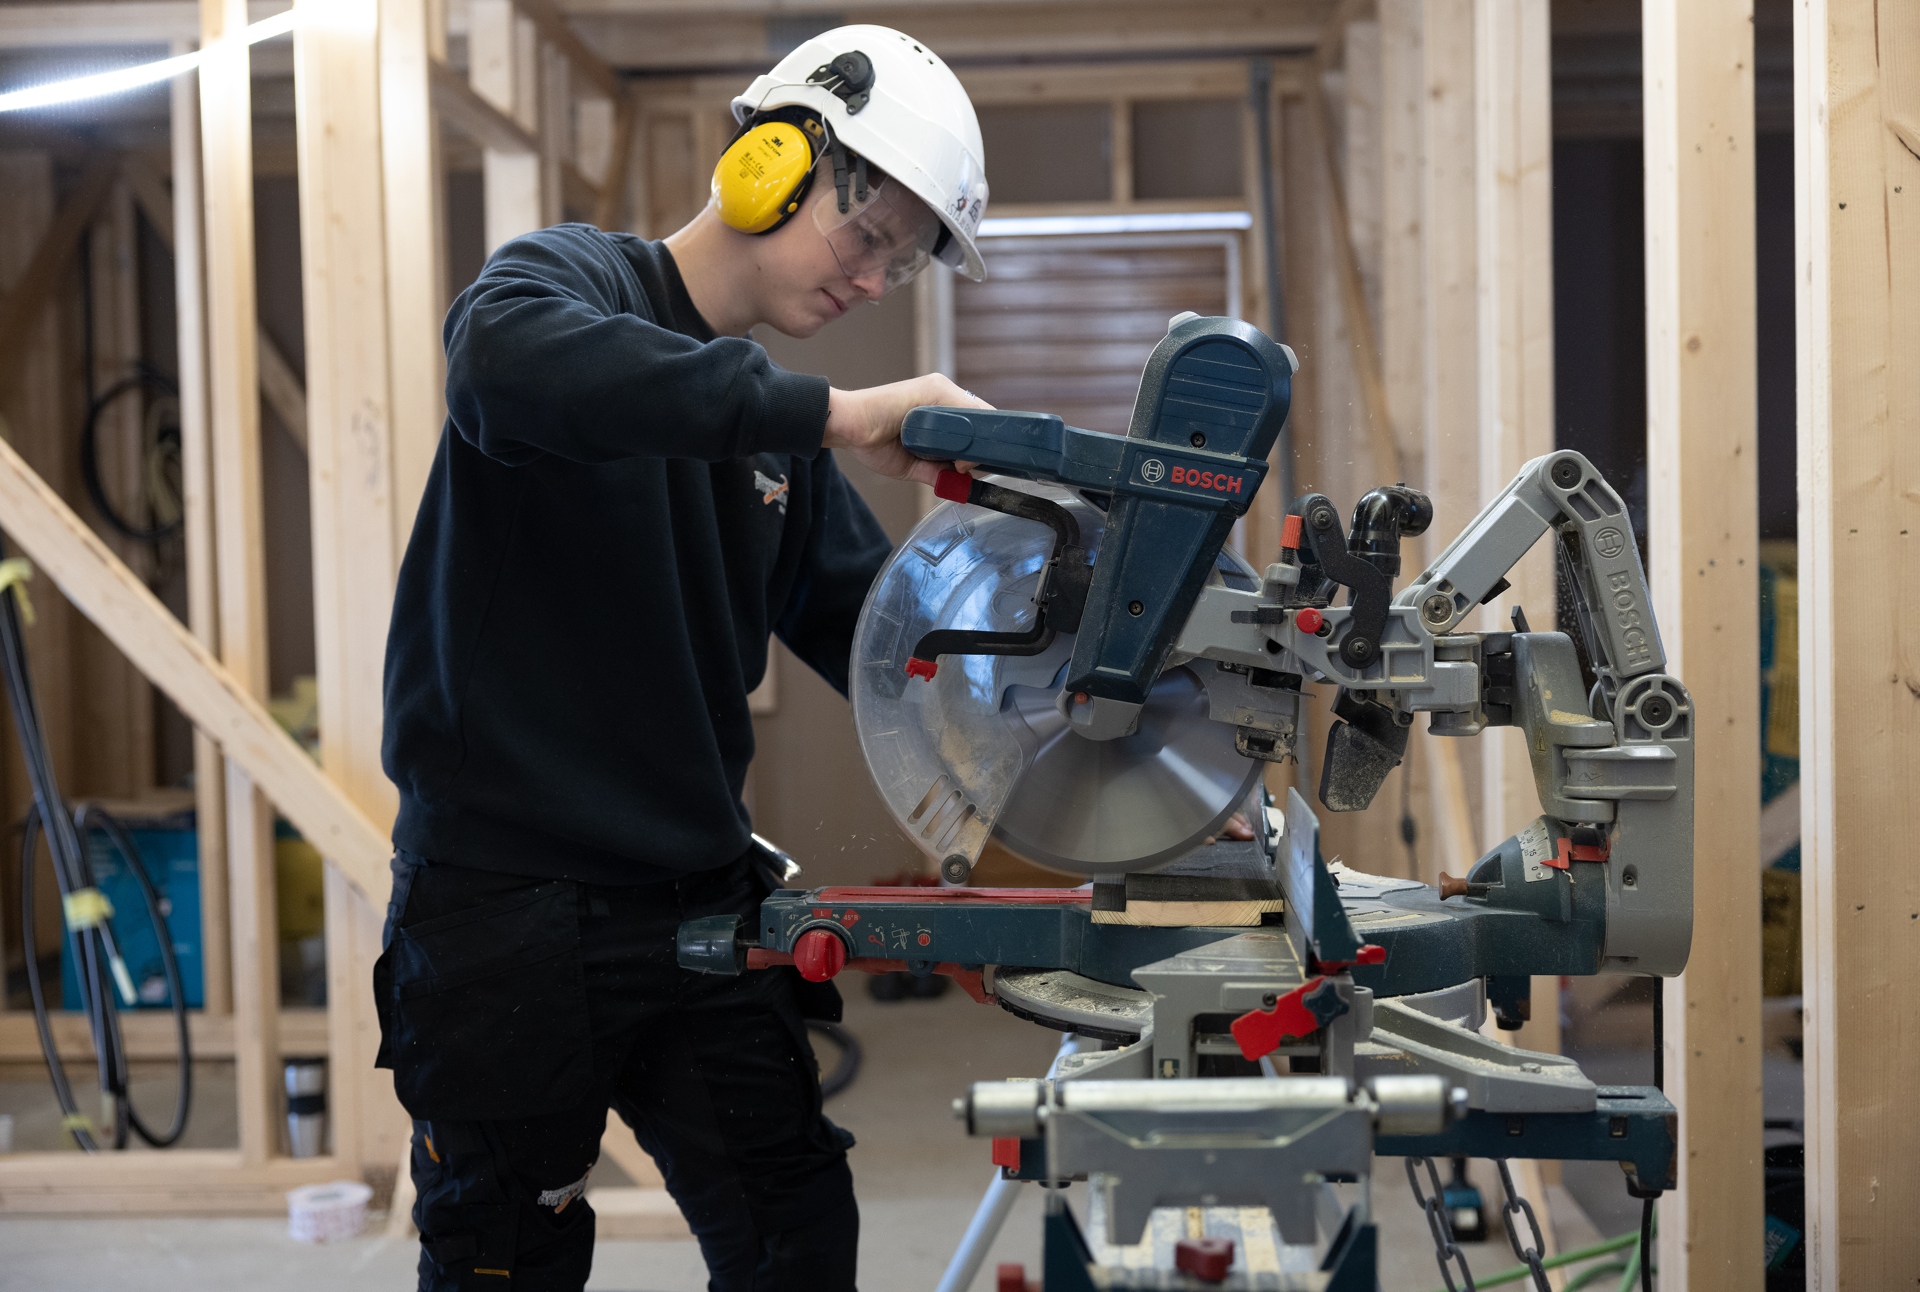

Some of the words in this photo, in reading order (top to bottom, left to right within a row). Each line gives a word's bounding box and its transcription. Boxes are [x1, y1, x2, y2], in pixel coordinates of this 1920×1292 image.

[771, 136, 783, 147] 3M
[1171, 466, 1242, 494] BOSCH
[1606, 570, 1651, 667] BOSCH
[1529, 849, 1537, 857] 15
